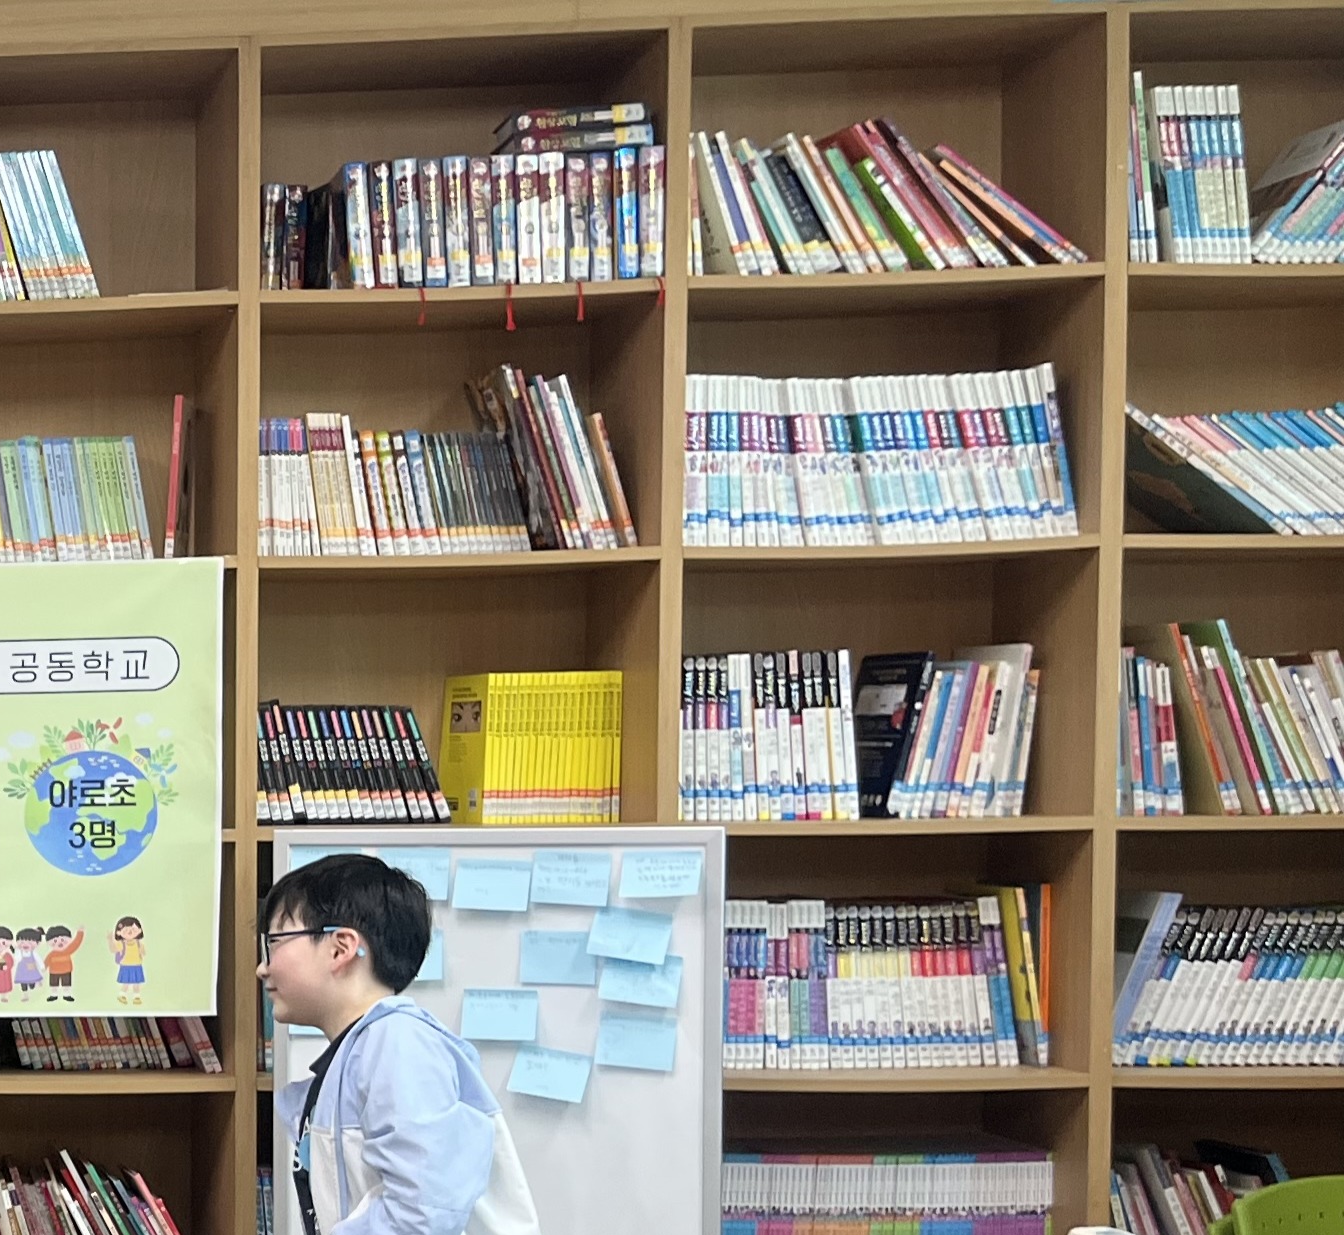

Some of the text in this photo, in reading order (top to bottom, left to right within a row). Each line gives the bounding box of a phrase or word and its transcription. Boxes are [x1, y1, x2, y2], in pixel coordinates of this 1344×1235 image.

[8, 648, 152, 685] 공동학교
[48, 777, 138, 809] 야로초
[68, 821, 118, 851] 3명
